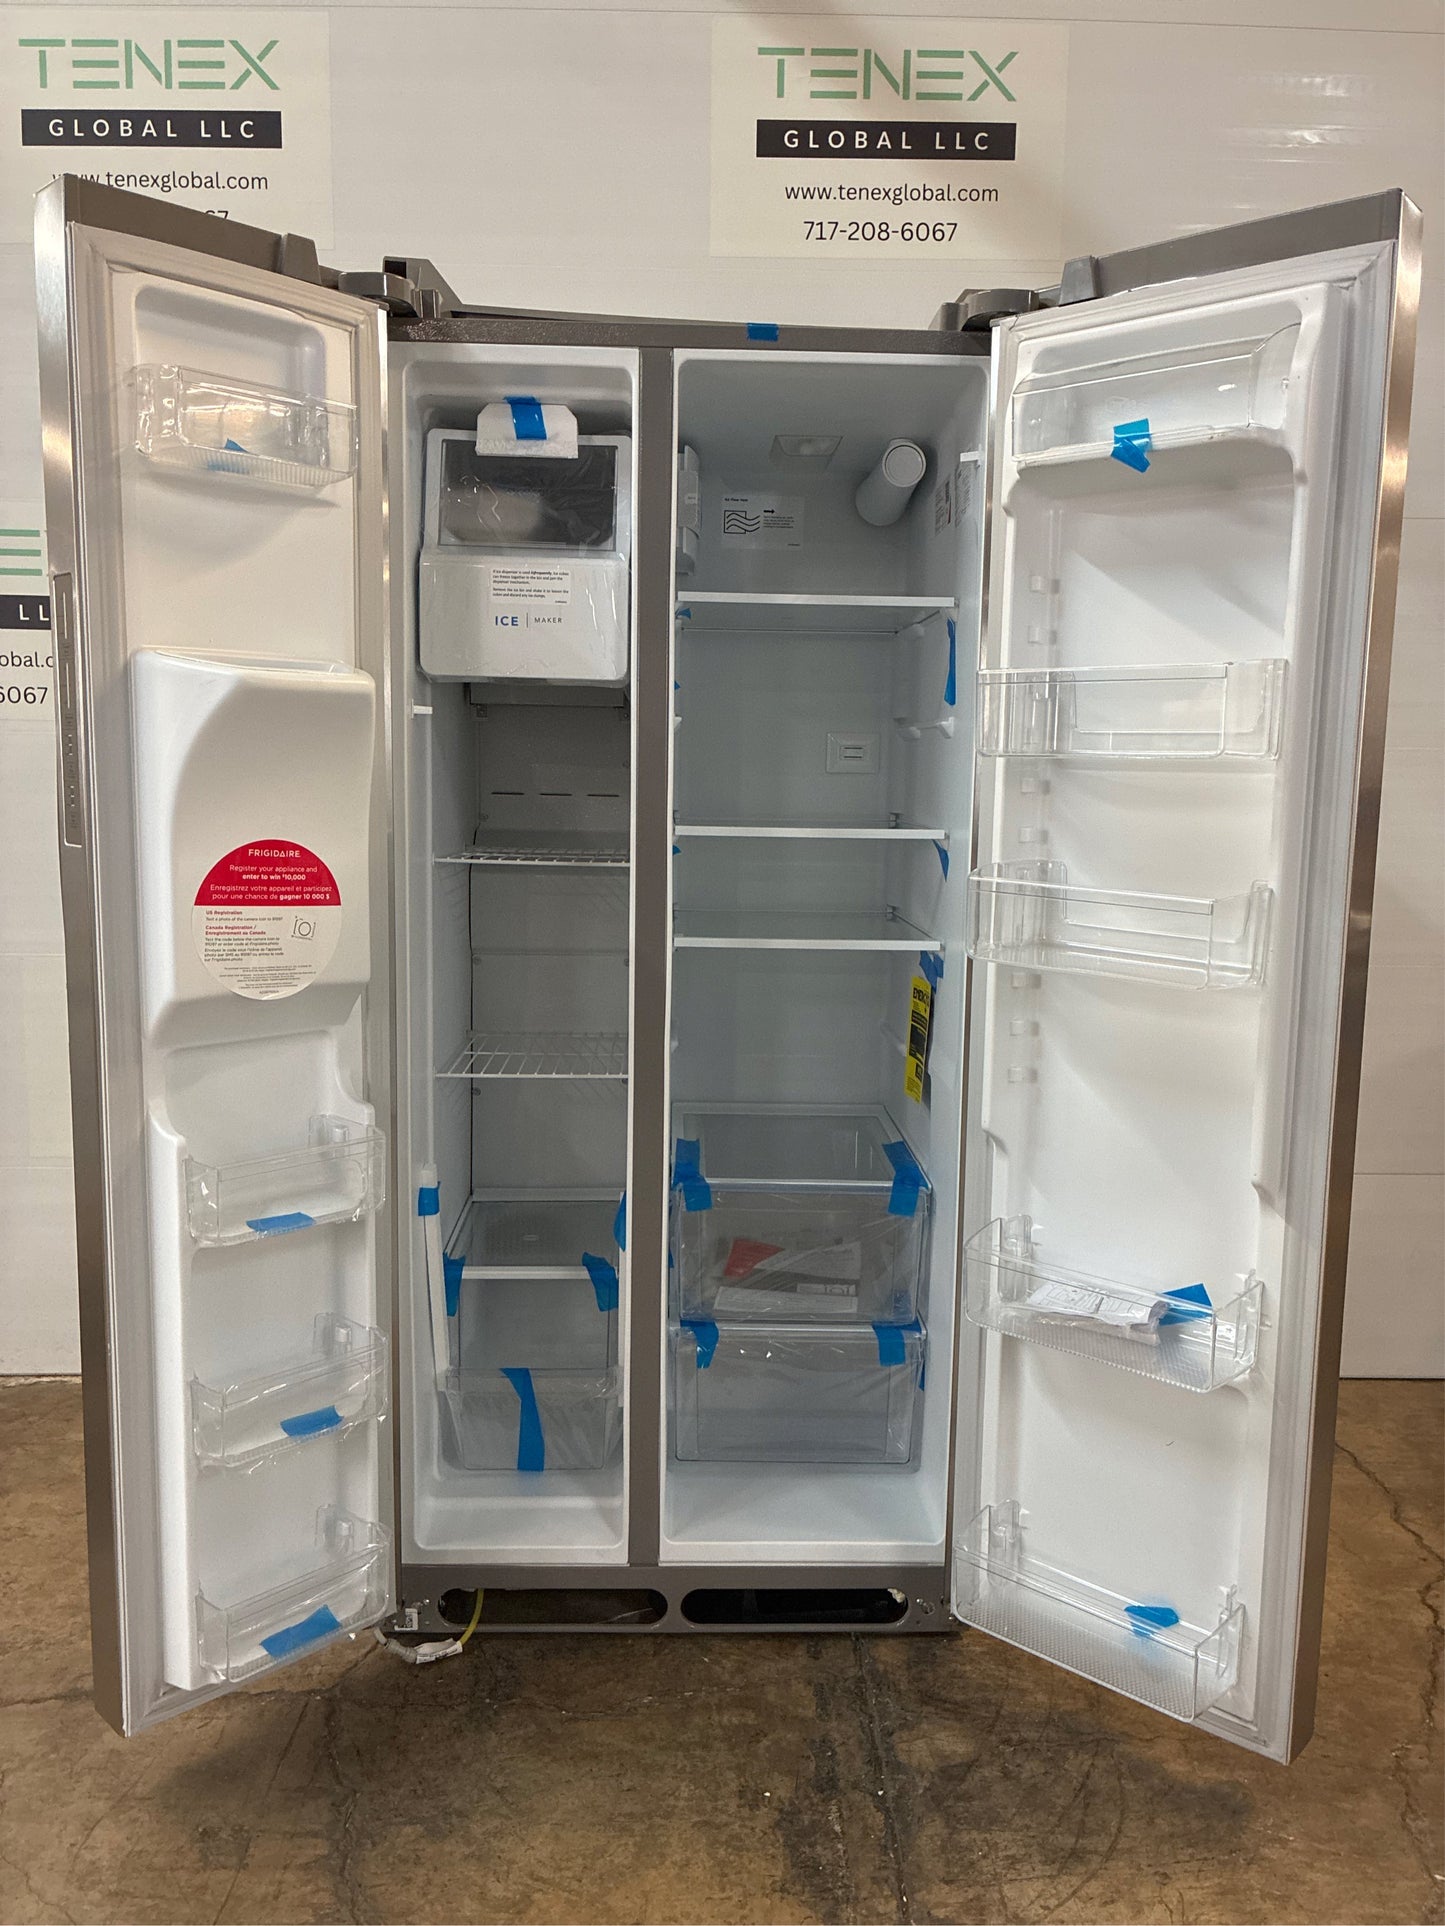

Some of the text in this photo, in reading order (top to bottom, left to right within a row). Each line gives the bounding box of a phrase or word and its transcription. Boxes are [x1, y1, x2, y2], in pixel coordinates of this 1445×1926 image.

[18, 38, 280, 90] TENEX
[757, 47, 1019, 102] TENEX
[48, 118, 255, 139] GLOBAL LLC
[783, 129, 989, 151] GLOBAL LLC
[784, 183, 999, 206] www.tenexglobal.com
[802, 221, 958, 242] 717-208-6067
[495, 616, 519, 626] ICE
[248, 849, 301, 858] FRIGIDAIRE
[229, 864, 257, 872] Register
